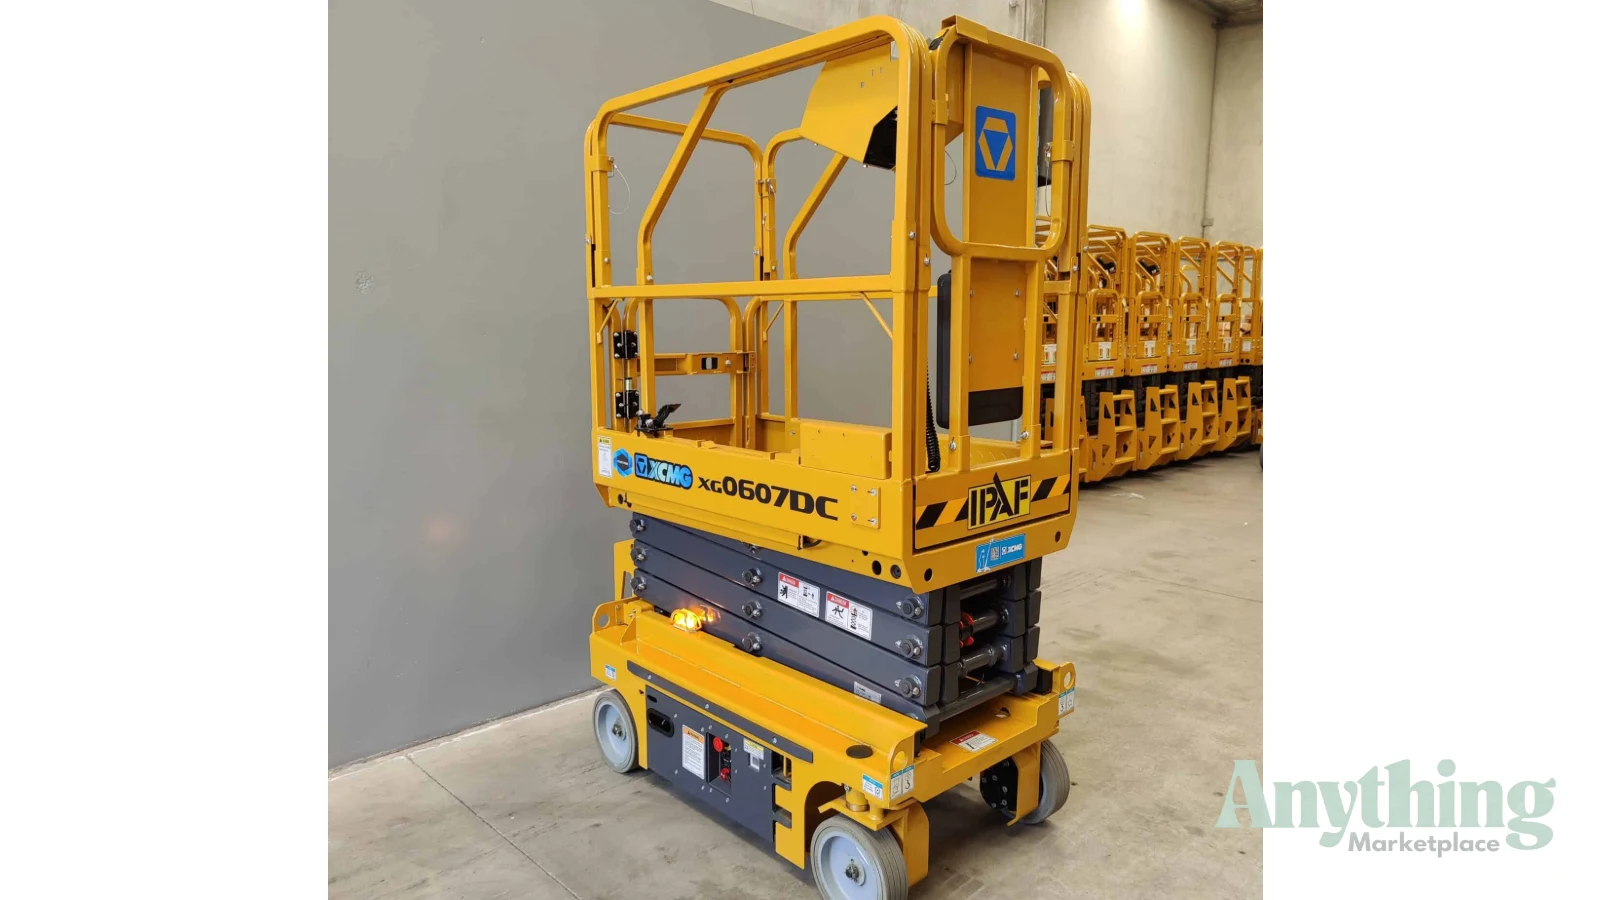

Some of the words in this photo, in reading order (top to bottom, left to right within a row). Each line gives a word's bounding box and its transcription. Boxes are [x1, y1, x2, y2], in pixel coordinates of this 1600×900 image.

[648, 459, 692, 489] XCMG
[697, 476, 838, 521] XG0607DC
[970, 472, 1029, 527] IPAF
